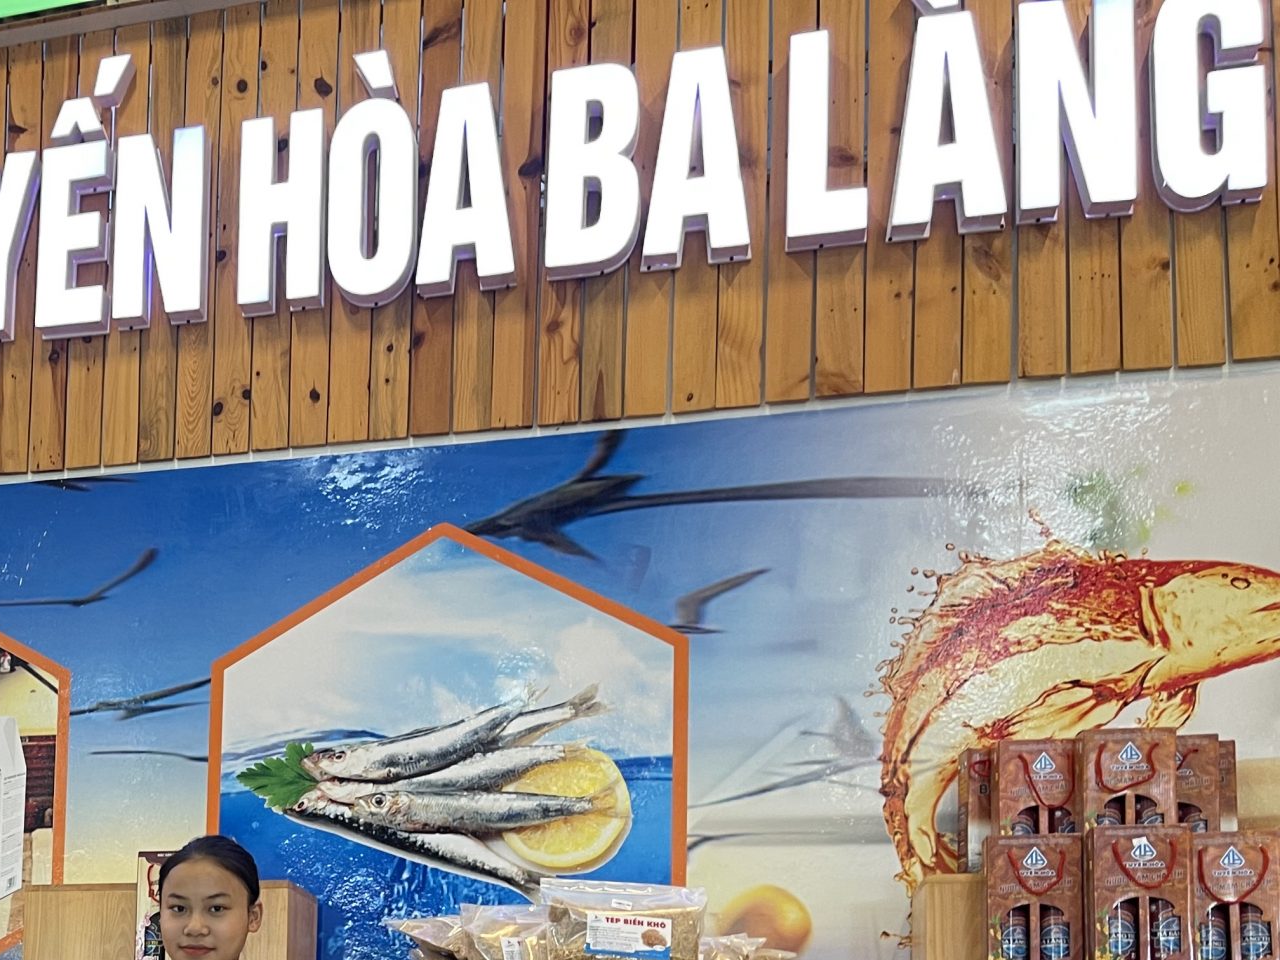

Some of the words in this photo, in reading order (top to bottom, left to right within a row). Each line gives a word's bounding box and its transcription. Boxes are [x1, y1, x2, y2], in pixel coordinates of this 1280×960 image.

[236, 49, 516, 306] HÒA
[545, 46, 752, 270] BA
[785, 0, 1268, 240] LÀNG
